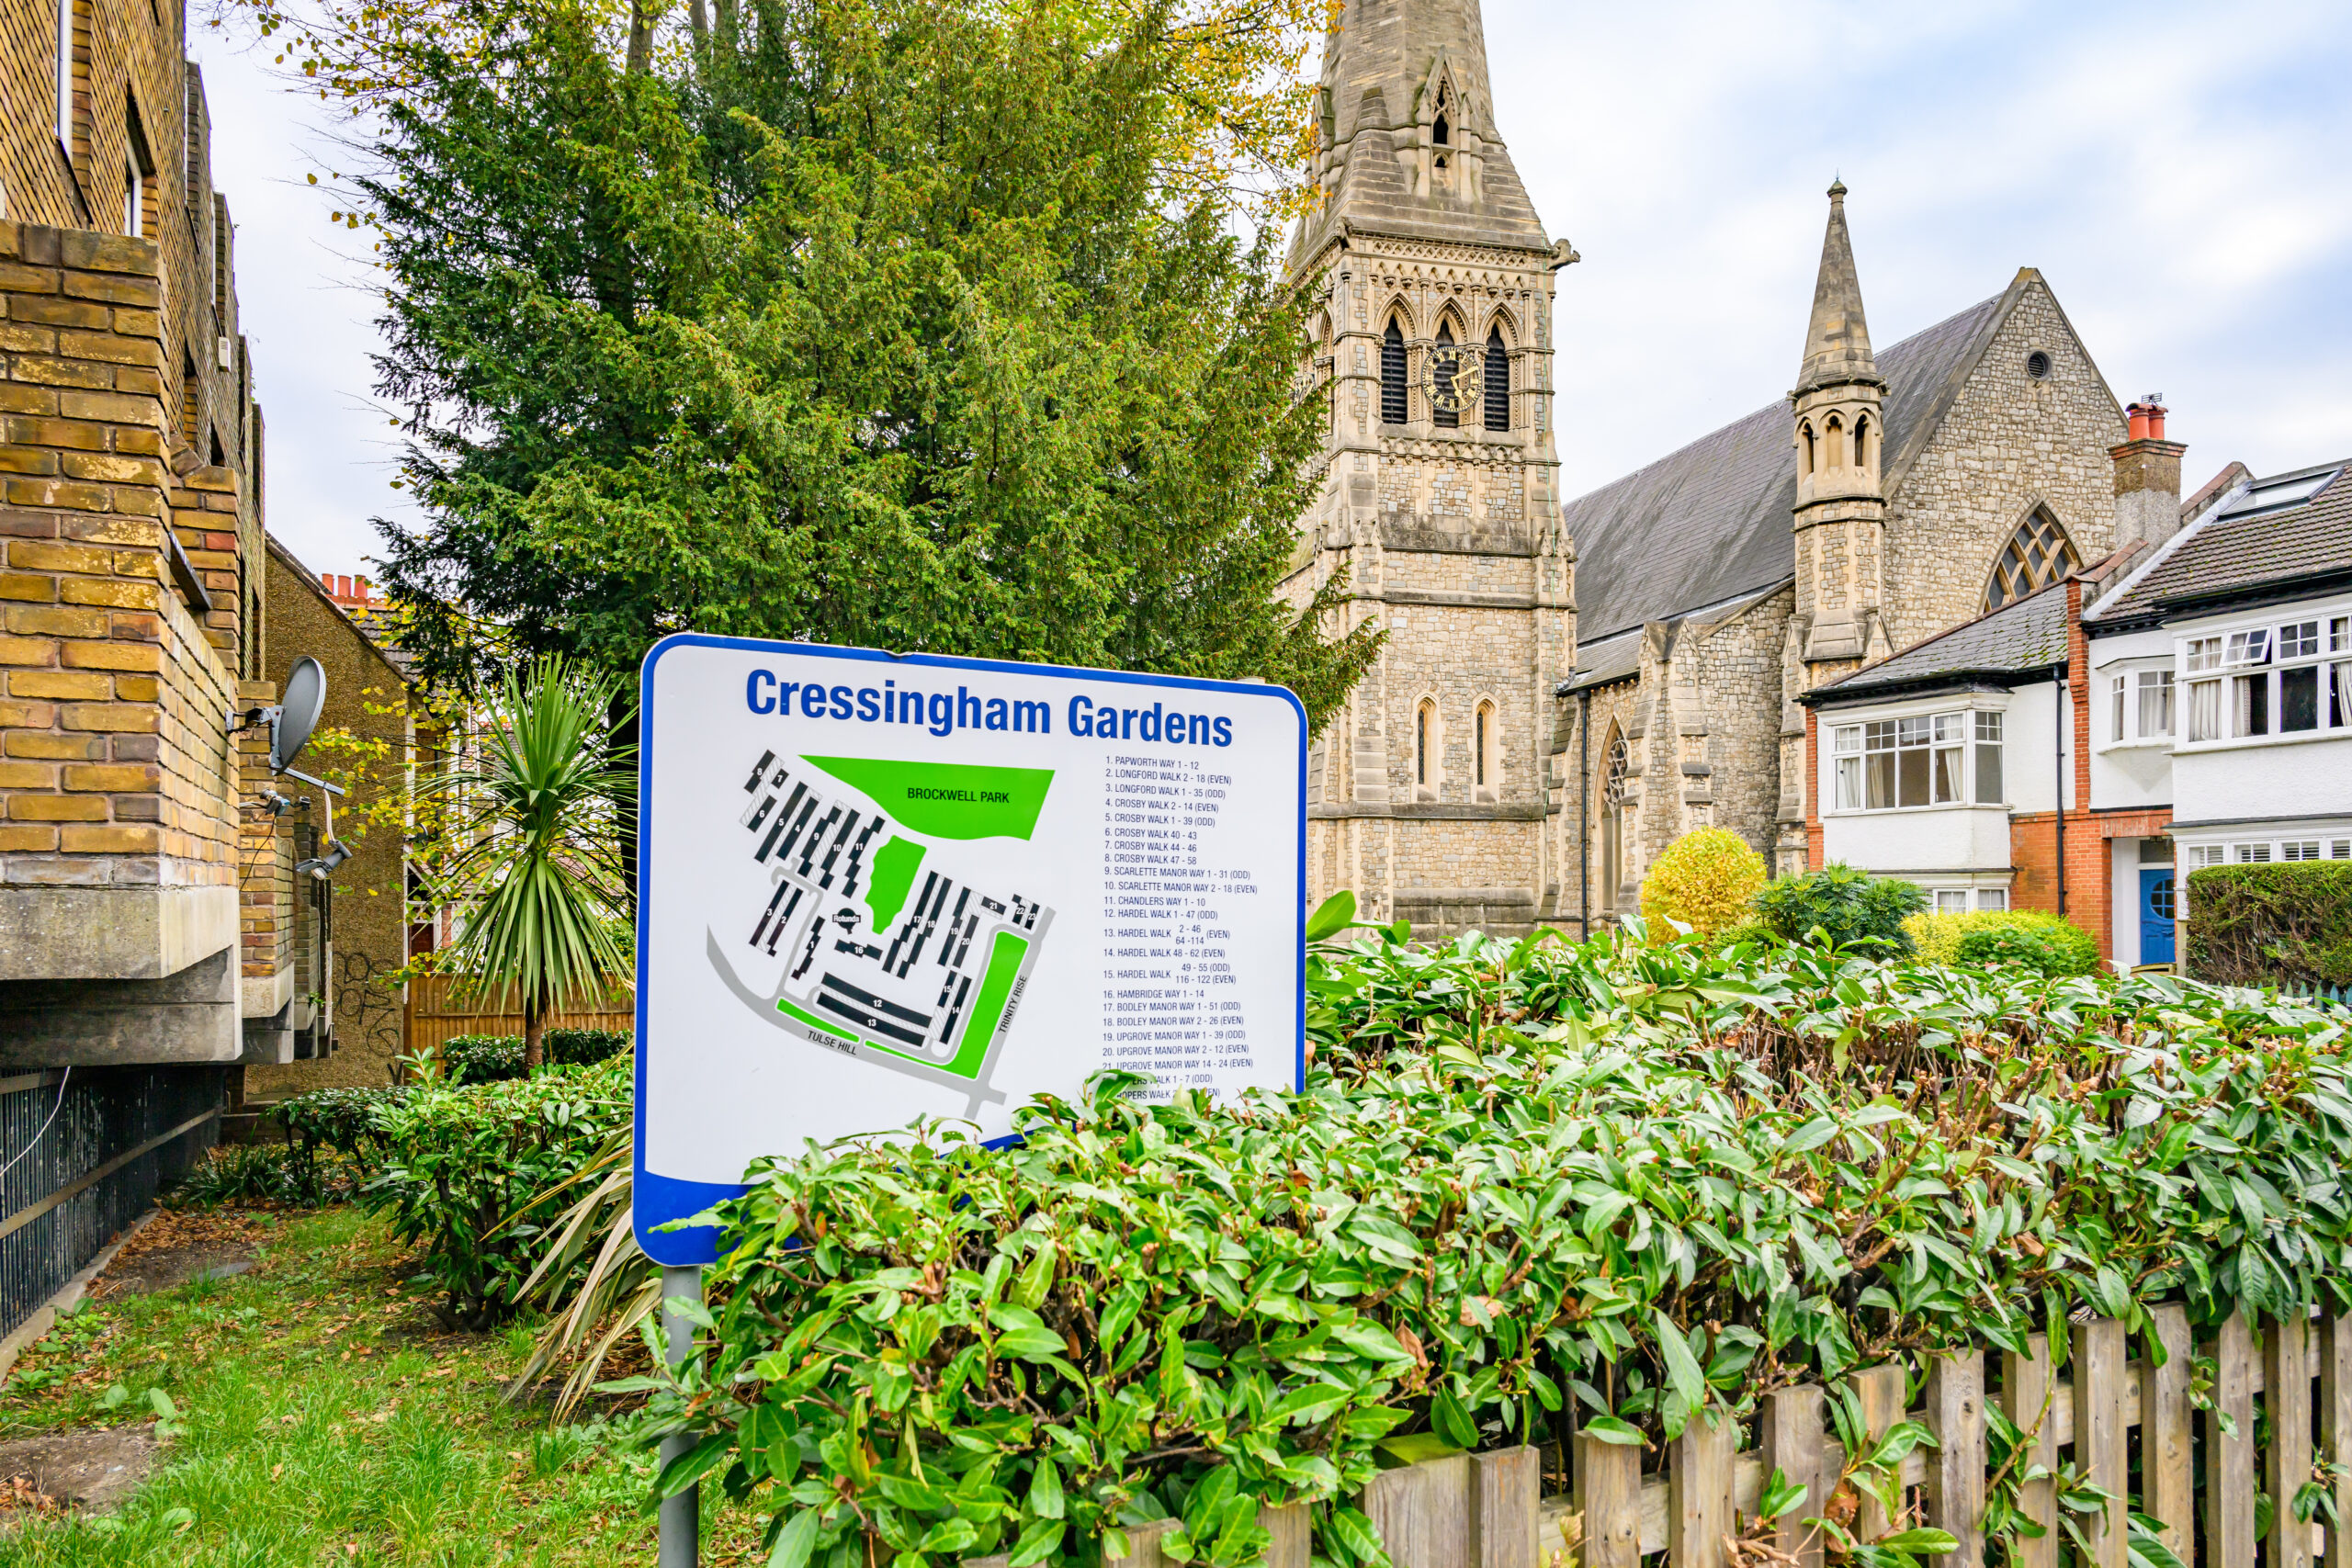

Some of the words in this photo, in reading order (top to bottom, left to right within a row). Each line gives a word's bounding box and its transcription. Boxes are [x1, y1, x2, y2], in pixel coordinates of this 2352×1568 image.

[746, 669, 1051, 737] Cressingham
[1068, 694, 1233, 747] Gardens
[1116, 756, 1157, 766] PAPWORTH
[1160, 759, 1175, 768] WAY
[1106, 769, 1112, 777] 2.
[1116, 769, 1157, 779] LONGFORD
[1160, 772, 1181, 781] WALK
[1197, 774, 1205, 783] 18
[1208, 775, 1231, 785] (EVEN)
[908, 788, 977, 801] BROCKWELL
[980, 792, 1010, 803] PARK
[1106, 783, 1112, 792] 3.
[1115, 784, 1156, 794] LONGFORD
[1158, 787, 1179, 795] WALK
[1205, 789, 1225, 799] (ODD)
[1115, 799, 1146, 808] CROSBY
[1148, 801, 1169, 809] WALK
[1195, 803, 1218, 813] (EVEN)
[1106, 813, 1112, 821] 5.
[1115, 813, 1145, 822] CROSBY
[1184, 817, 1192, 825] 39
[1195, 817, 1215, 827] (ODD)
[1105, 828, 1112, 836] 6.
[1115, 828, 1145, 837] CROSBY
[1115, 841, 1145, 850] CROSBY
[1147, 843, 1168, 851] WALK
[1105, 854, 1111, 862] 8.
[1115, 854, 1145, 863] CROSBY
[1147, 855, 1168, 864] WALK
[1105, 866, 1111, 875] 9.
[1115, 867, 1157, 876] SCARLETTE
[1160, 868, 1187, 877] MANOR
[1230, 871, 1250, 879] (ODD)
[1119, 882, 1161, 891] SCARLETTE
[1164, 883, 1191, 891] MANOR
[1235, 885, 1257, 894] (EVEN)
[1118, 896, 1164, 905] CHANDLERS
[1118, 909, 1148, 918] HARDEL
[1198, 911, 1217, 919] (ODD)
[1105, 929, 1116, 937] 13.
[1118, 929, 1148, 937] HARDEL
[1207, 930, 1230, 939] (EVEN)
[1202, 949, 1225, 958] (EVEN)
[1210, 963, 1230, 973] (ODD)
[1104, 970, 1114, 978] 15.
[1118, 970, 1147, 978] HARDEL
[1213, 975, 1236, 984] (EVEN)
[999, 999, 1018, 1033] TRINITY
[1013, 976, 1027, 997] RISE
[1117, 1003, 1147, 1011] BODLEY
[1150, 1002, 1177, 1011] MANOR
[1221, 1002, 1240, 1011] (ODD)
[1117, 1018, 1147, 1026] BODLEY
[1150, 1017, 1177, 1025] MANOR
[1221, 1016, 1243, 1025] (EVEN)
[1117, 1032, 1151, 1041] UPGROVE
[1226, 1030, 1245, 1039] (ODD)
[808, 1031, 836, 1048] TULSE
[838, 1043, 857, 1055] HILL
[1117, 1047, 1152, 1056] UPGROVE
[1226, 1045, 1248, 1053] (EVEN)
[1117, 1061, 1152, 1070] UPGROVE
[1155, 1061, 1182, 1069] MANOR
[1230, 1059, 1253, 1068] (EVEN)
[1192, 1074, 1212, 1083] (ODD)
[1149, 1090, 1170, 1099] WALK
